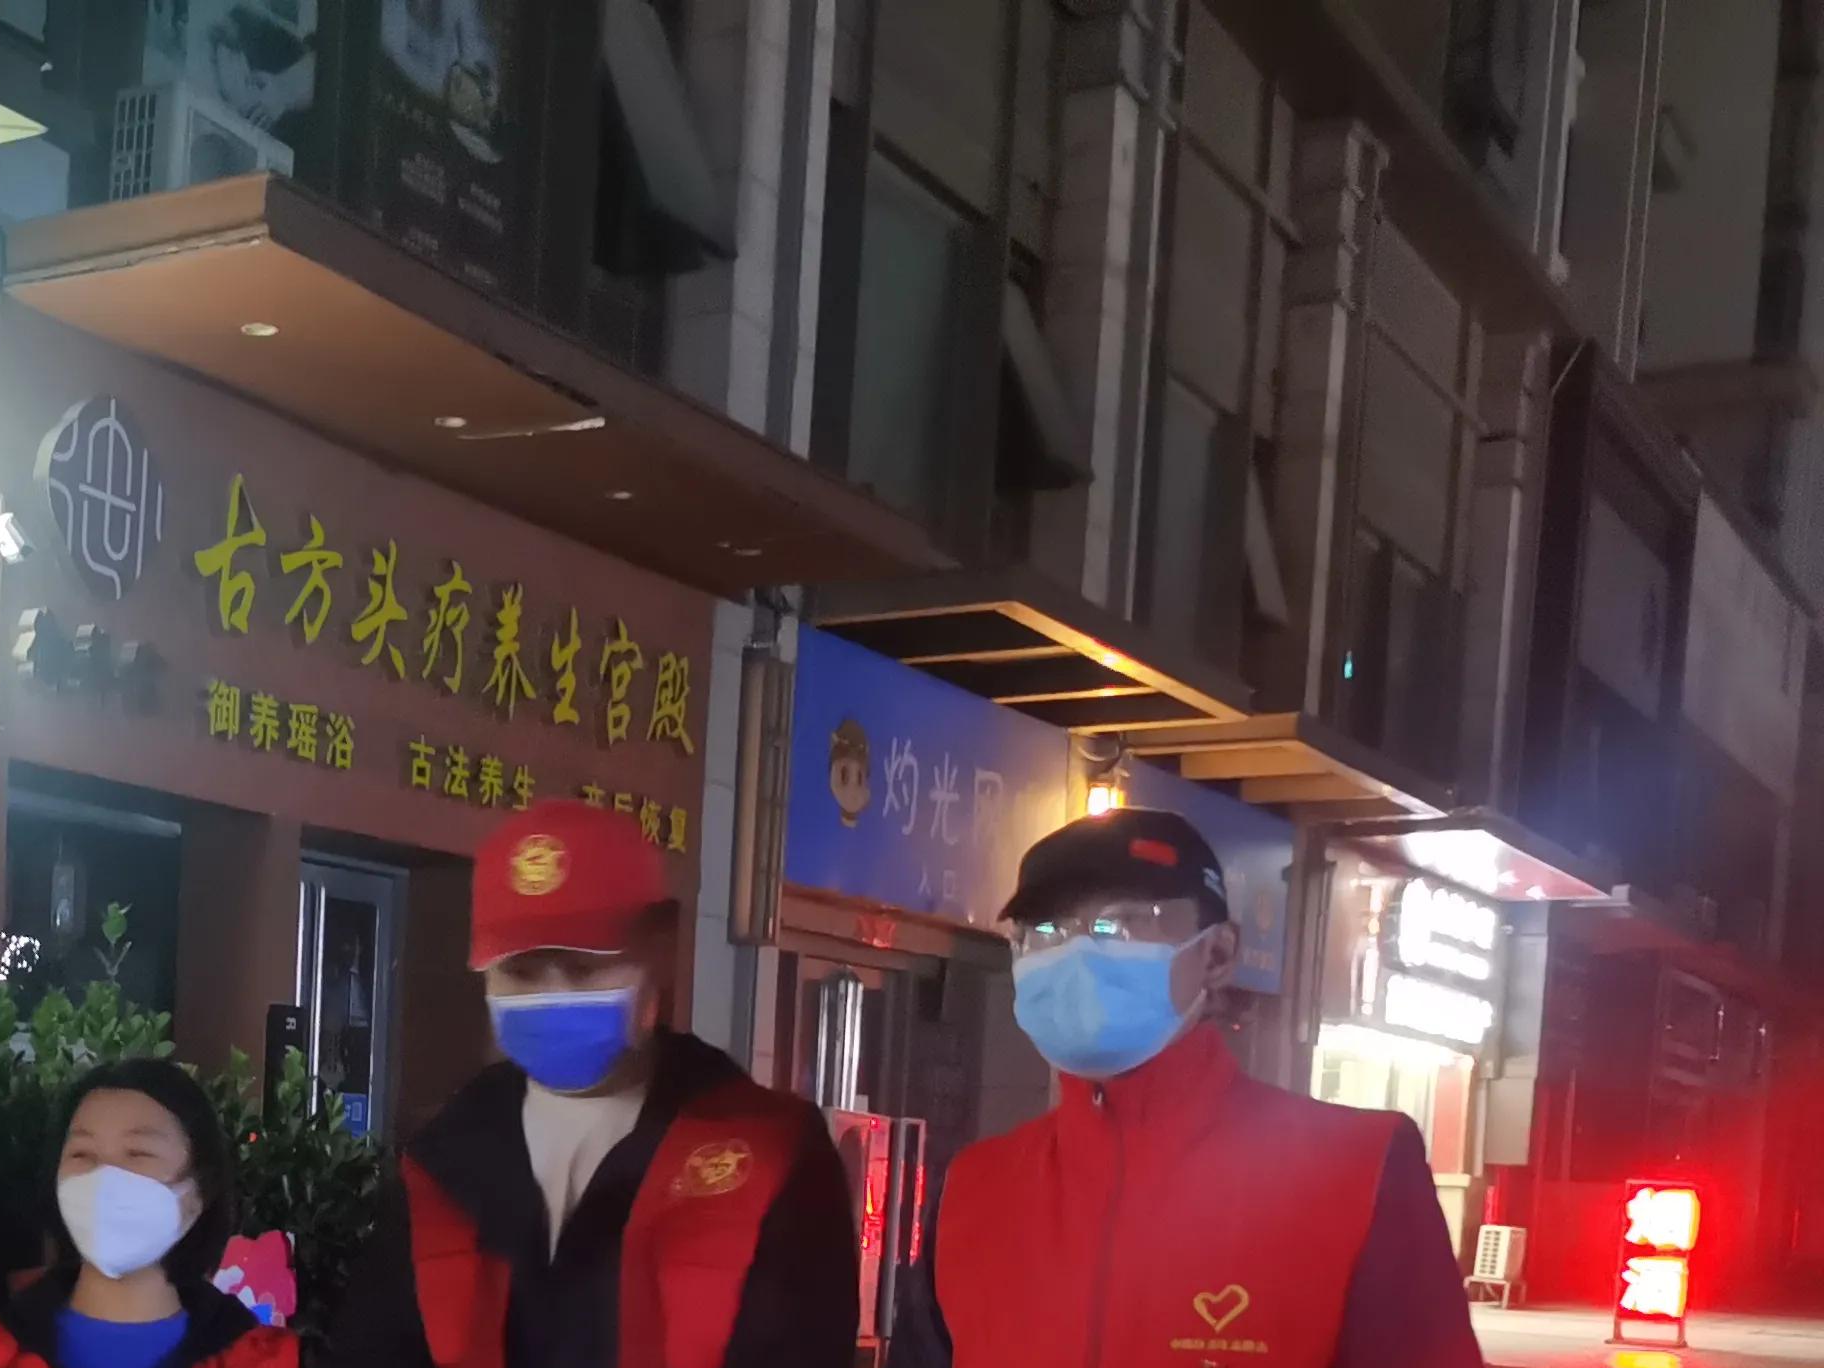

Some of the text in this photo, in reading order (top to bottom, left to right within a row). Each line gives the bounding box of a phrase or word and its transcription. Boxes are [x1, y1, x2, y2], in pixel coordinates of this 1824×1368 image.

[193, 471, 695, 755] 古方头疗养生宫殿
[206, 680, 356, 769] 御养瑶浴
[409, 734, 536, 811] 古法养生
